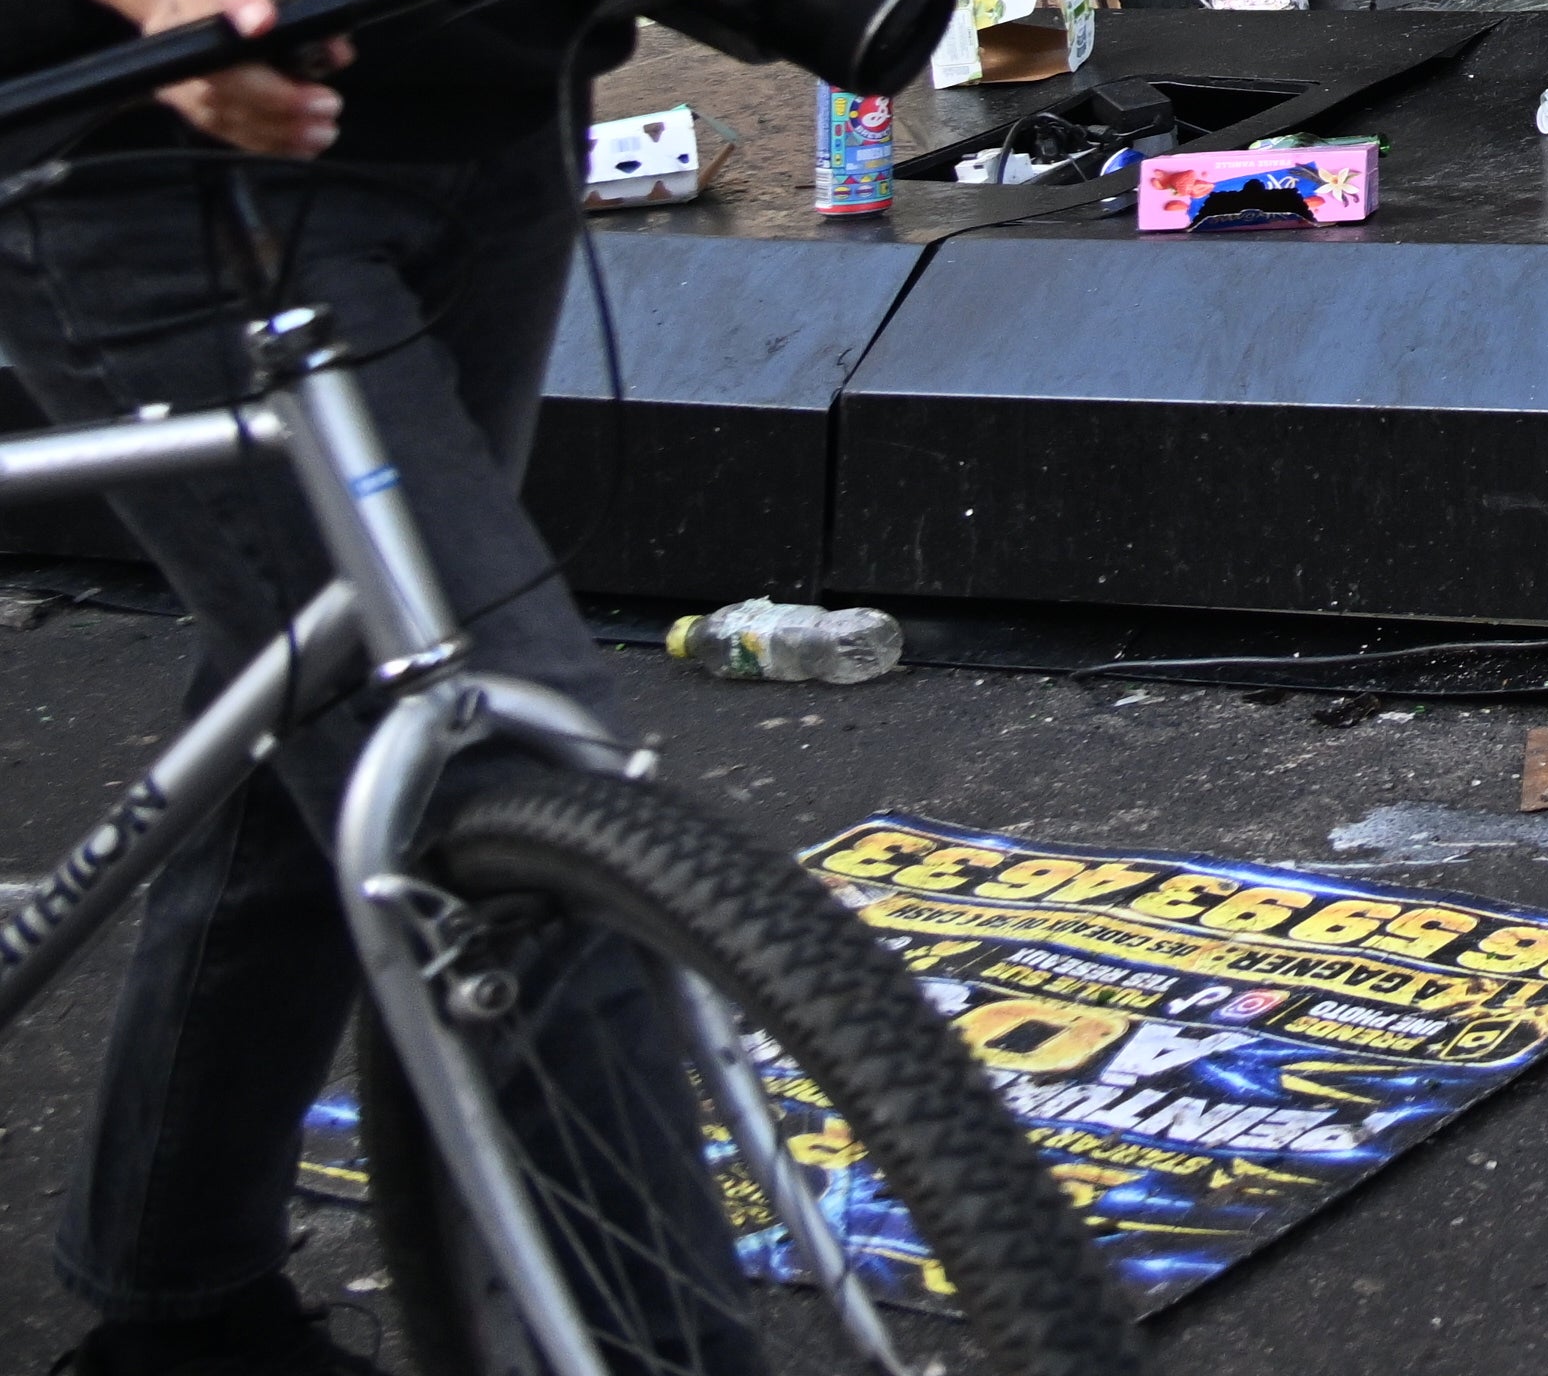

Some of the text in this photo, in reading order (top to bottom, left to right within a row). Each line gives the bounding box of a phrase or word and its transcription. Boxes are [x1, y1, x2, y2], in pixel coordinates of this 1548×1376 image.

[822, 831, 1005, 891] 33
[975, 858, 1160, 902] 46
[885, 903, 968, 924] CASH
[1130, 874, 1317, 933] 93
[1049, 918, 1150, 948] CADEAUX
[1287, 898, 1482, 959] 59
[1150, 938, 1198, 956] DES
[979, 961, 1052, 987] SUR
[1121, 971, 1181, 992] TES
[1227, 951, 1415, 994] GAGNER
[1284, 1016, 1428, 1051] PRENDS
[1308, 1000, 1448, 1035] UNE PHOTO
[985, 1070, 1402, 1152] PEINTUR
